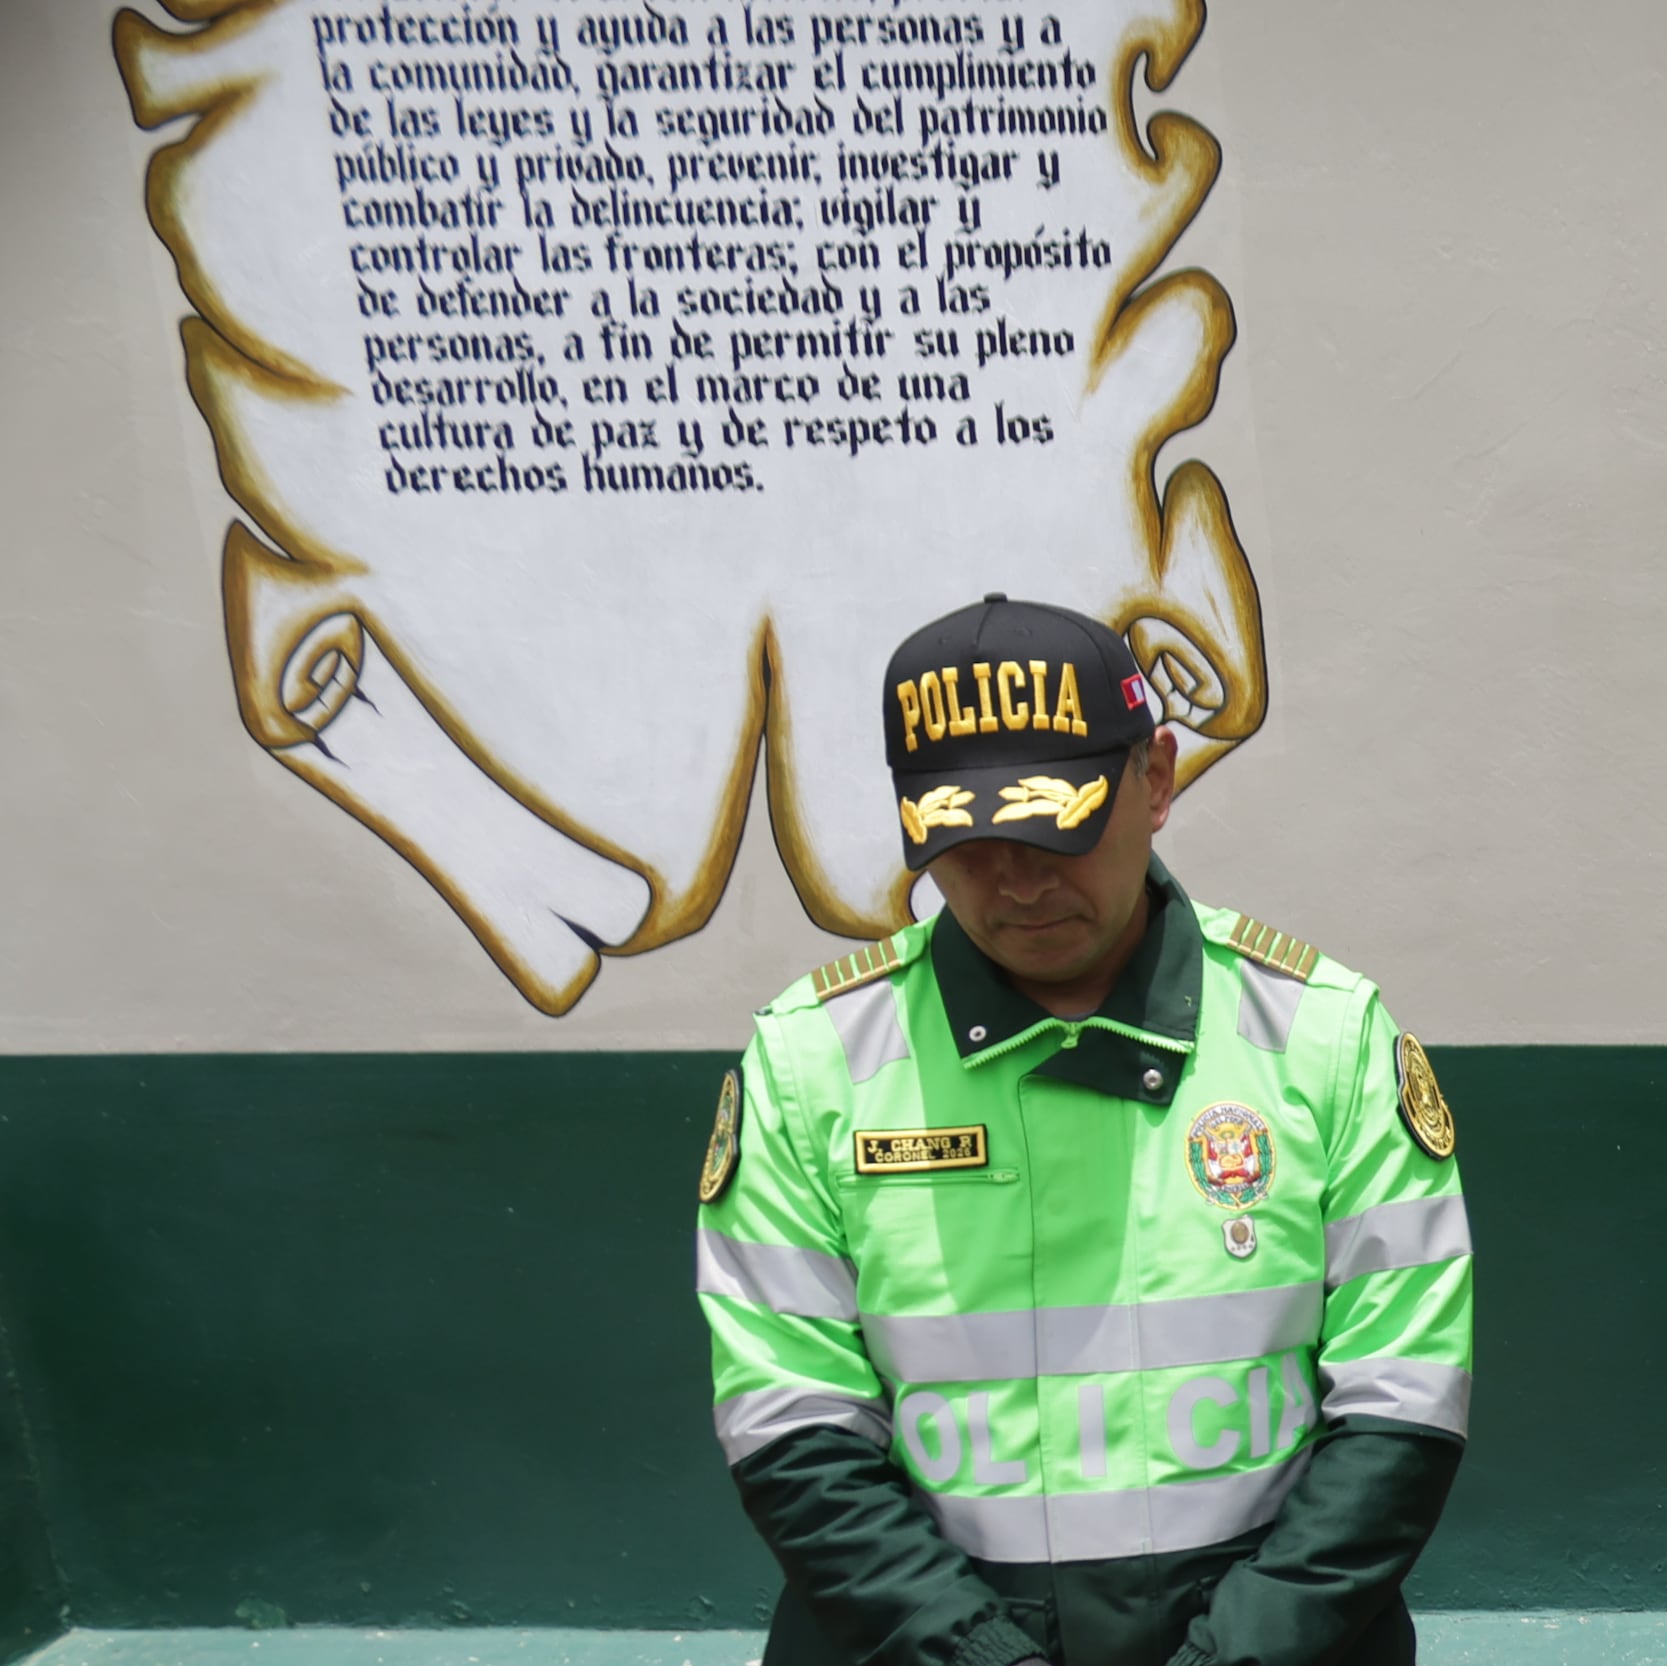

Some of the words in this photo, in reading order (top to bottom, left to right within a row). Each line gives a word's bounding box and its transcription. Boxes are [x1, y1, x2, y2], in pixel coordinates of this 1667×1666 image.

[313, 5, 518, 55] protección
[537, 18, 558, 55] y
[578, 6, 688, 55] ayuda
[707, 16, 728, 46] a
[745, 6, 794, 45] las
[811, 16, 984, 55] personas
[1002, 16, 1024, 55] y
[1040, 16, 1061, 45] a
[321, 52, 352, 91] la
[370, 52, 579, 101] comunidad,
[597, 52, 793, 101] garantizar
[814, 52, 845, 91] el
[862, 52, 1096, 101] cumplimiento
[330, 98, 370, 136] de
[389, 99, 440, 138] las
[457, 99, 554, 146] leyes
[570, 110, 591, 146] y
[607, 97, 638, 137] la
[656, 97, 835, 146] seguridad
[853, 97, 904, 135] del
[920, 96, 1109, 145] patrimonio
[335, 145, 459, 194] público
[477, 155, 499, 193] y
[515, 144, 653, 193] privado,
[838, 142, 1017, 191] investigar
[1038, 152, 1059, 190] y
[343, 189, 502, 228] combatir
[523, 189, 554, 228] la
[821, 187, 937, 236] vigilar
[959, 197, 980, 234] y
[350, 234, 521, 273] controlar
[540, 234, 592, 272] las
[817, 242, 880, 273] con
[898, 231, 928, 270] el
[945, 226, 1111, 279] propósito
[358, 279, 398, 317] de
[417, 278, 569, 317] defender
[591, 290, 611, 317] a
[629, 278, 659, 316] la
[678, 276, 843, 316] sociedad
[860, 287, 881, 324] y
[900, 286, 920, 314] a
[938, 274, 990, 314] las
[364, 333, 545, 373] personas,
[564, 333, 584, 360] a
[600, 322, 652, 361] fin
[671, 322, 714, 359] de
[731, 320, 892, 369] permitir
[915, 330, 959, 358] su
[977, 318, 1074, 367] pleno
[372, 365, 566, 414] desarrollo,
[583, 377, 627, 404] en
[646, 364, 678, 403] el
[696, 375, 819, 403] marco
[838, 362, 881, 401] de
[899, 374, 970, 401] una
[379, 411, 514, 451] cultura
[532, 409, 575, 448] de
[592, 421, 658, 457] paz
[678, 421, 703, 456] y
[722, 407, 768, 447] de
[784, 408, 937, 455] respeto
[956, 417, 977, 446] a
[997, 404, 1053, 444] los
[386, 455, 567, 494] derechos
[583, 452, 763, 492] humanos.
[897, 660, 1087, 753] POLICIA
[875, 1151, 936, 1163] CORONEL
[891, 1137, 951, 1152] CHANG
[900, 1352, 1316, 1485] OLICIA
